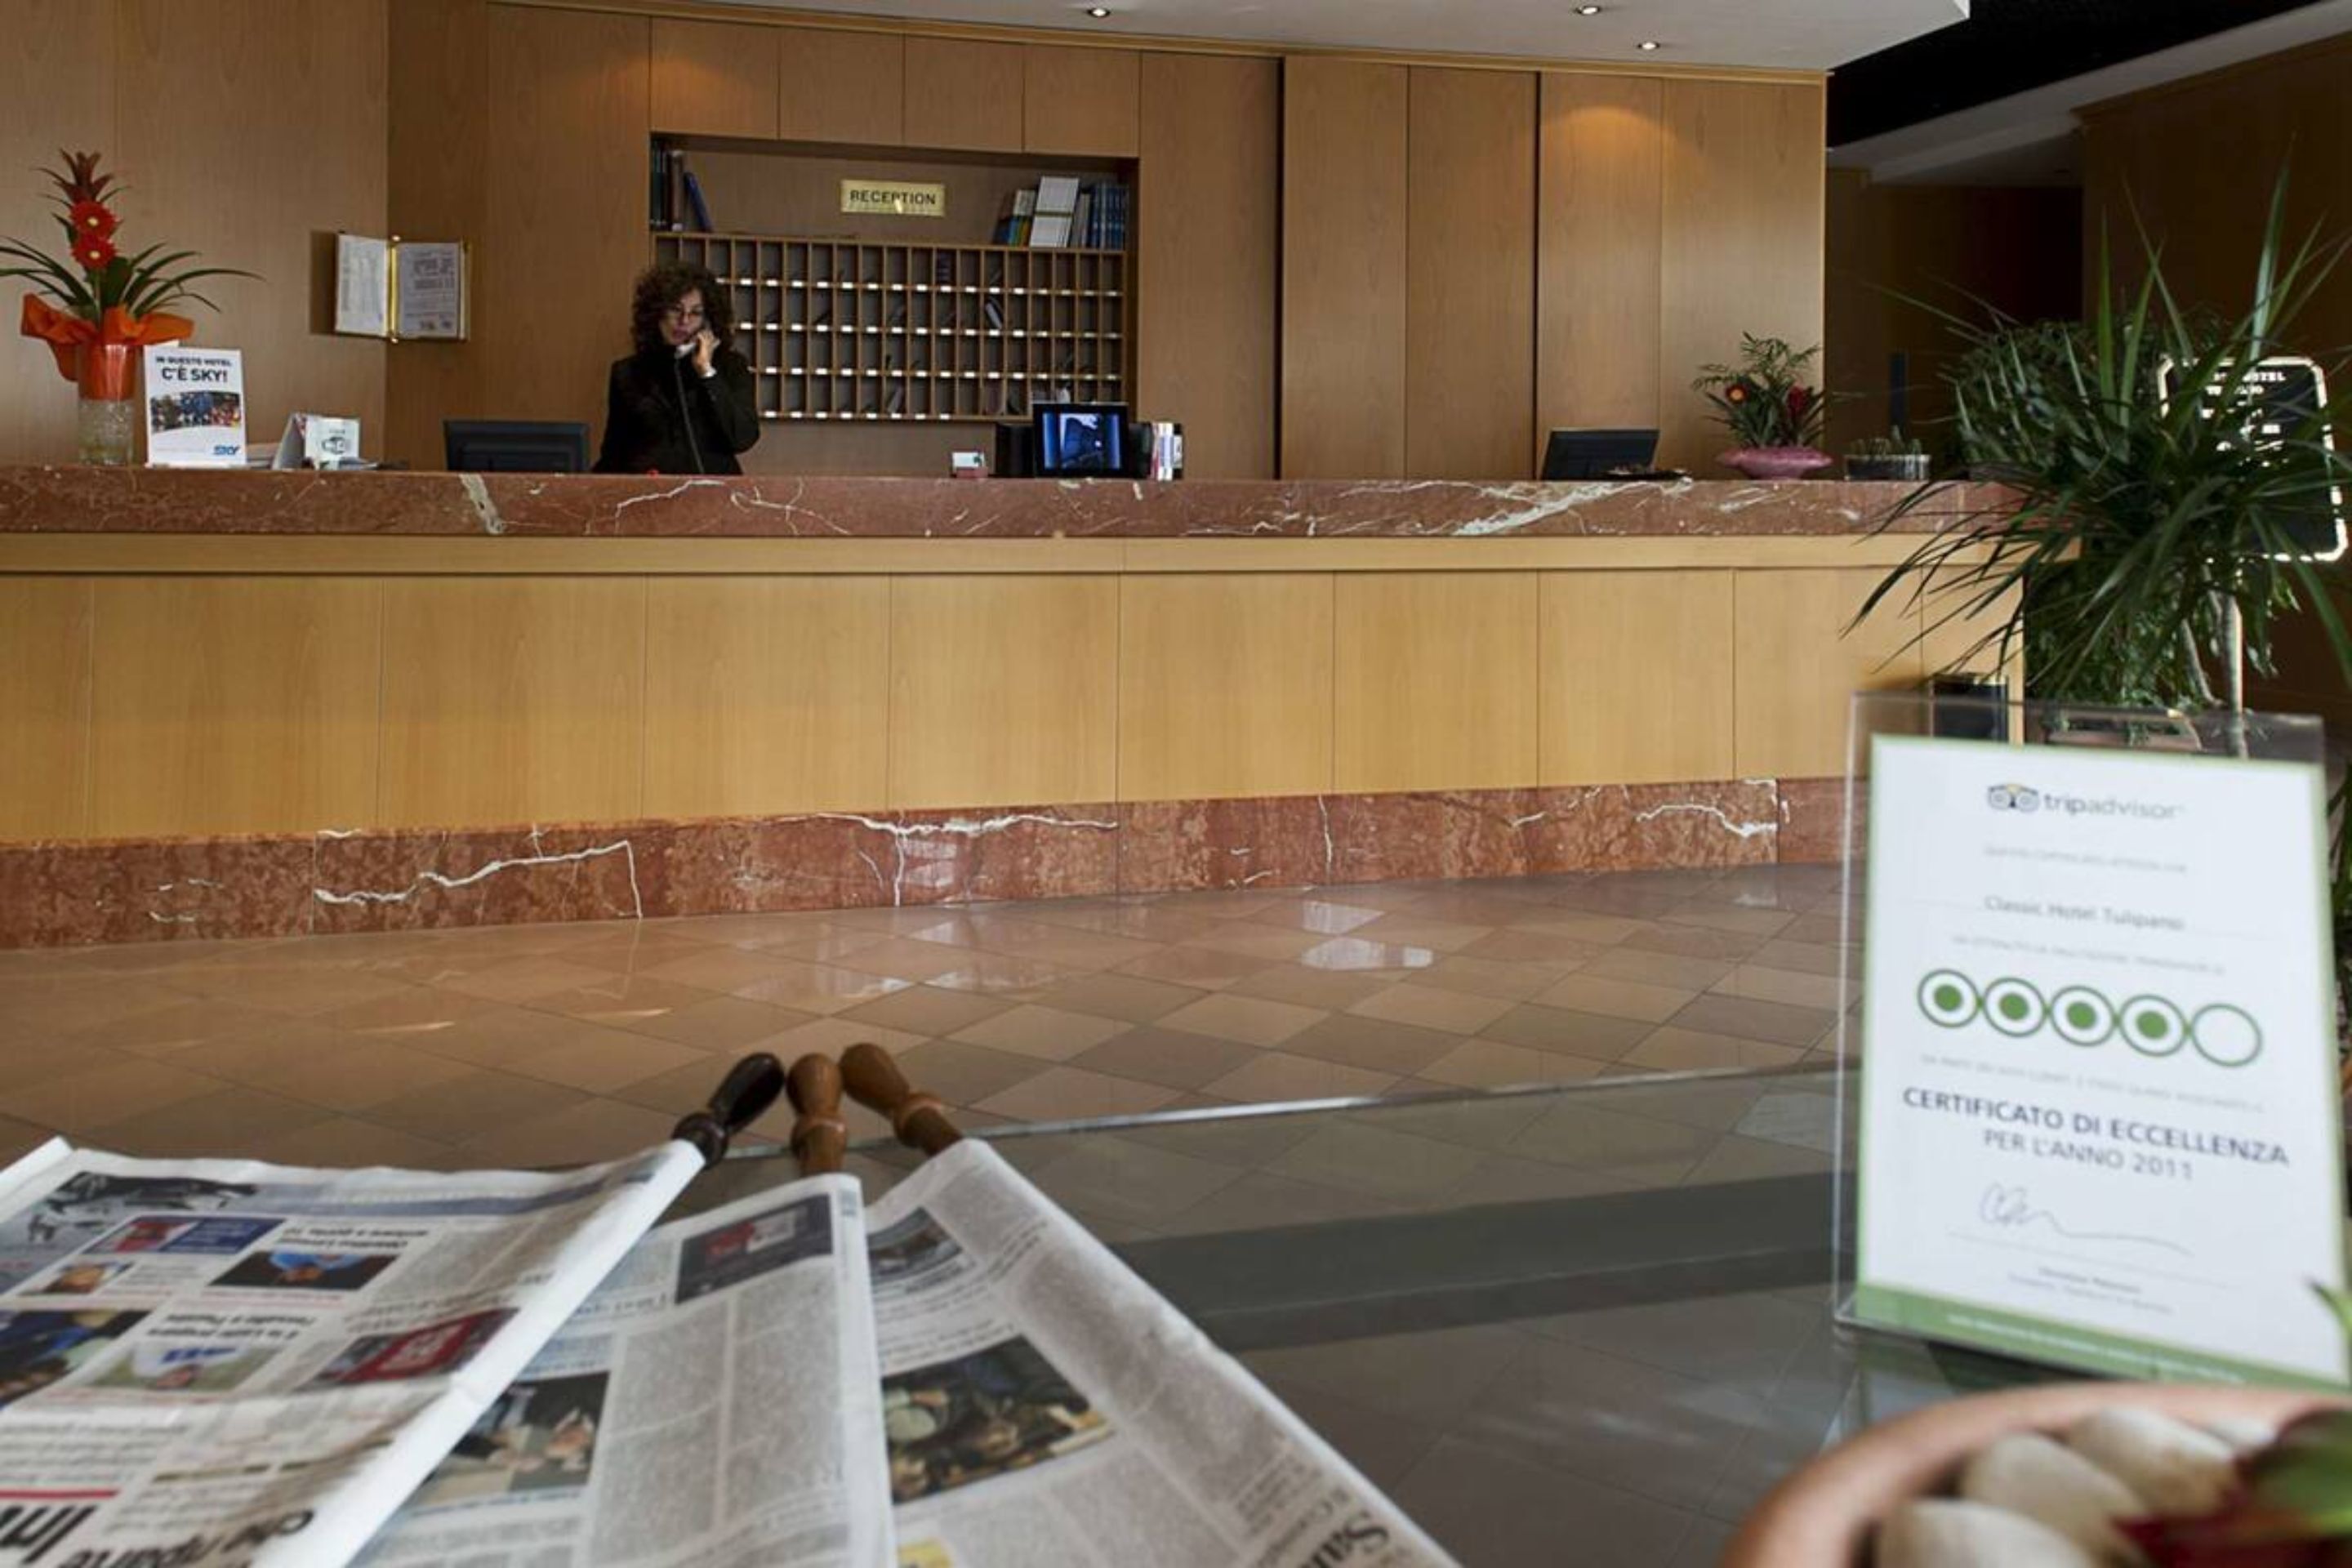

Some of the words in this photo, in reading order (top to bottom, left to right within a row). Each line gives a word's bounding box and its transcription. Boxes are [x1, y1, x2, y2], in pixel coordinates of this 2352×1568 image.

[850, 189, 935, 205] RECEPTION
[204, 358, 232, 367] HOTEL
[191, 369, 228, 383] SKY!
[2044, 793, 2178, 819] tripadvisor
[1903, 1087, 2064, 1130] CERTIFICATO
[2074, 1112, 2100, 1136] DI
[2109, 1118, 2290, 1169] ECCELLENZA
[1984, 1129, 2026, 1152] PER
[2033, 1136, 2123, 1169] L'ANNO
[2132, 1151, 2193, 1181] 2011
